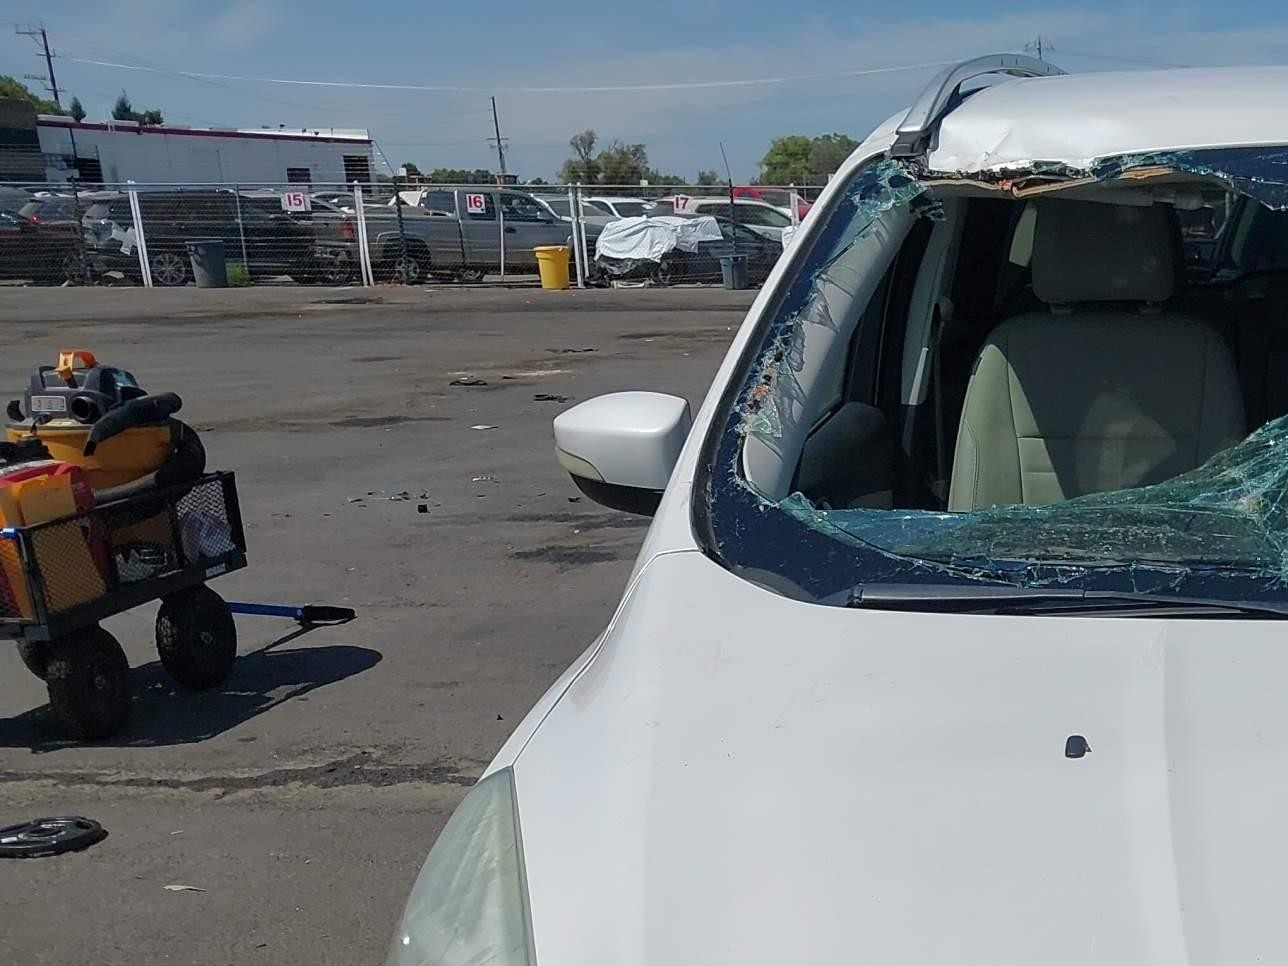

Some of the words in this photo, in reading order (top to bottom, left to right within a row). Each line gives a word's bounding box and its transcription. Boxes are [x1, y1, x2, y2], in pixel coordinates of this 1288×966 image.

[287, 193, 304, 207] 15
[467, 195, 484, 210] 16
[675, 196, 690, 210] 17
